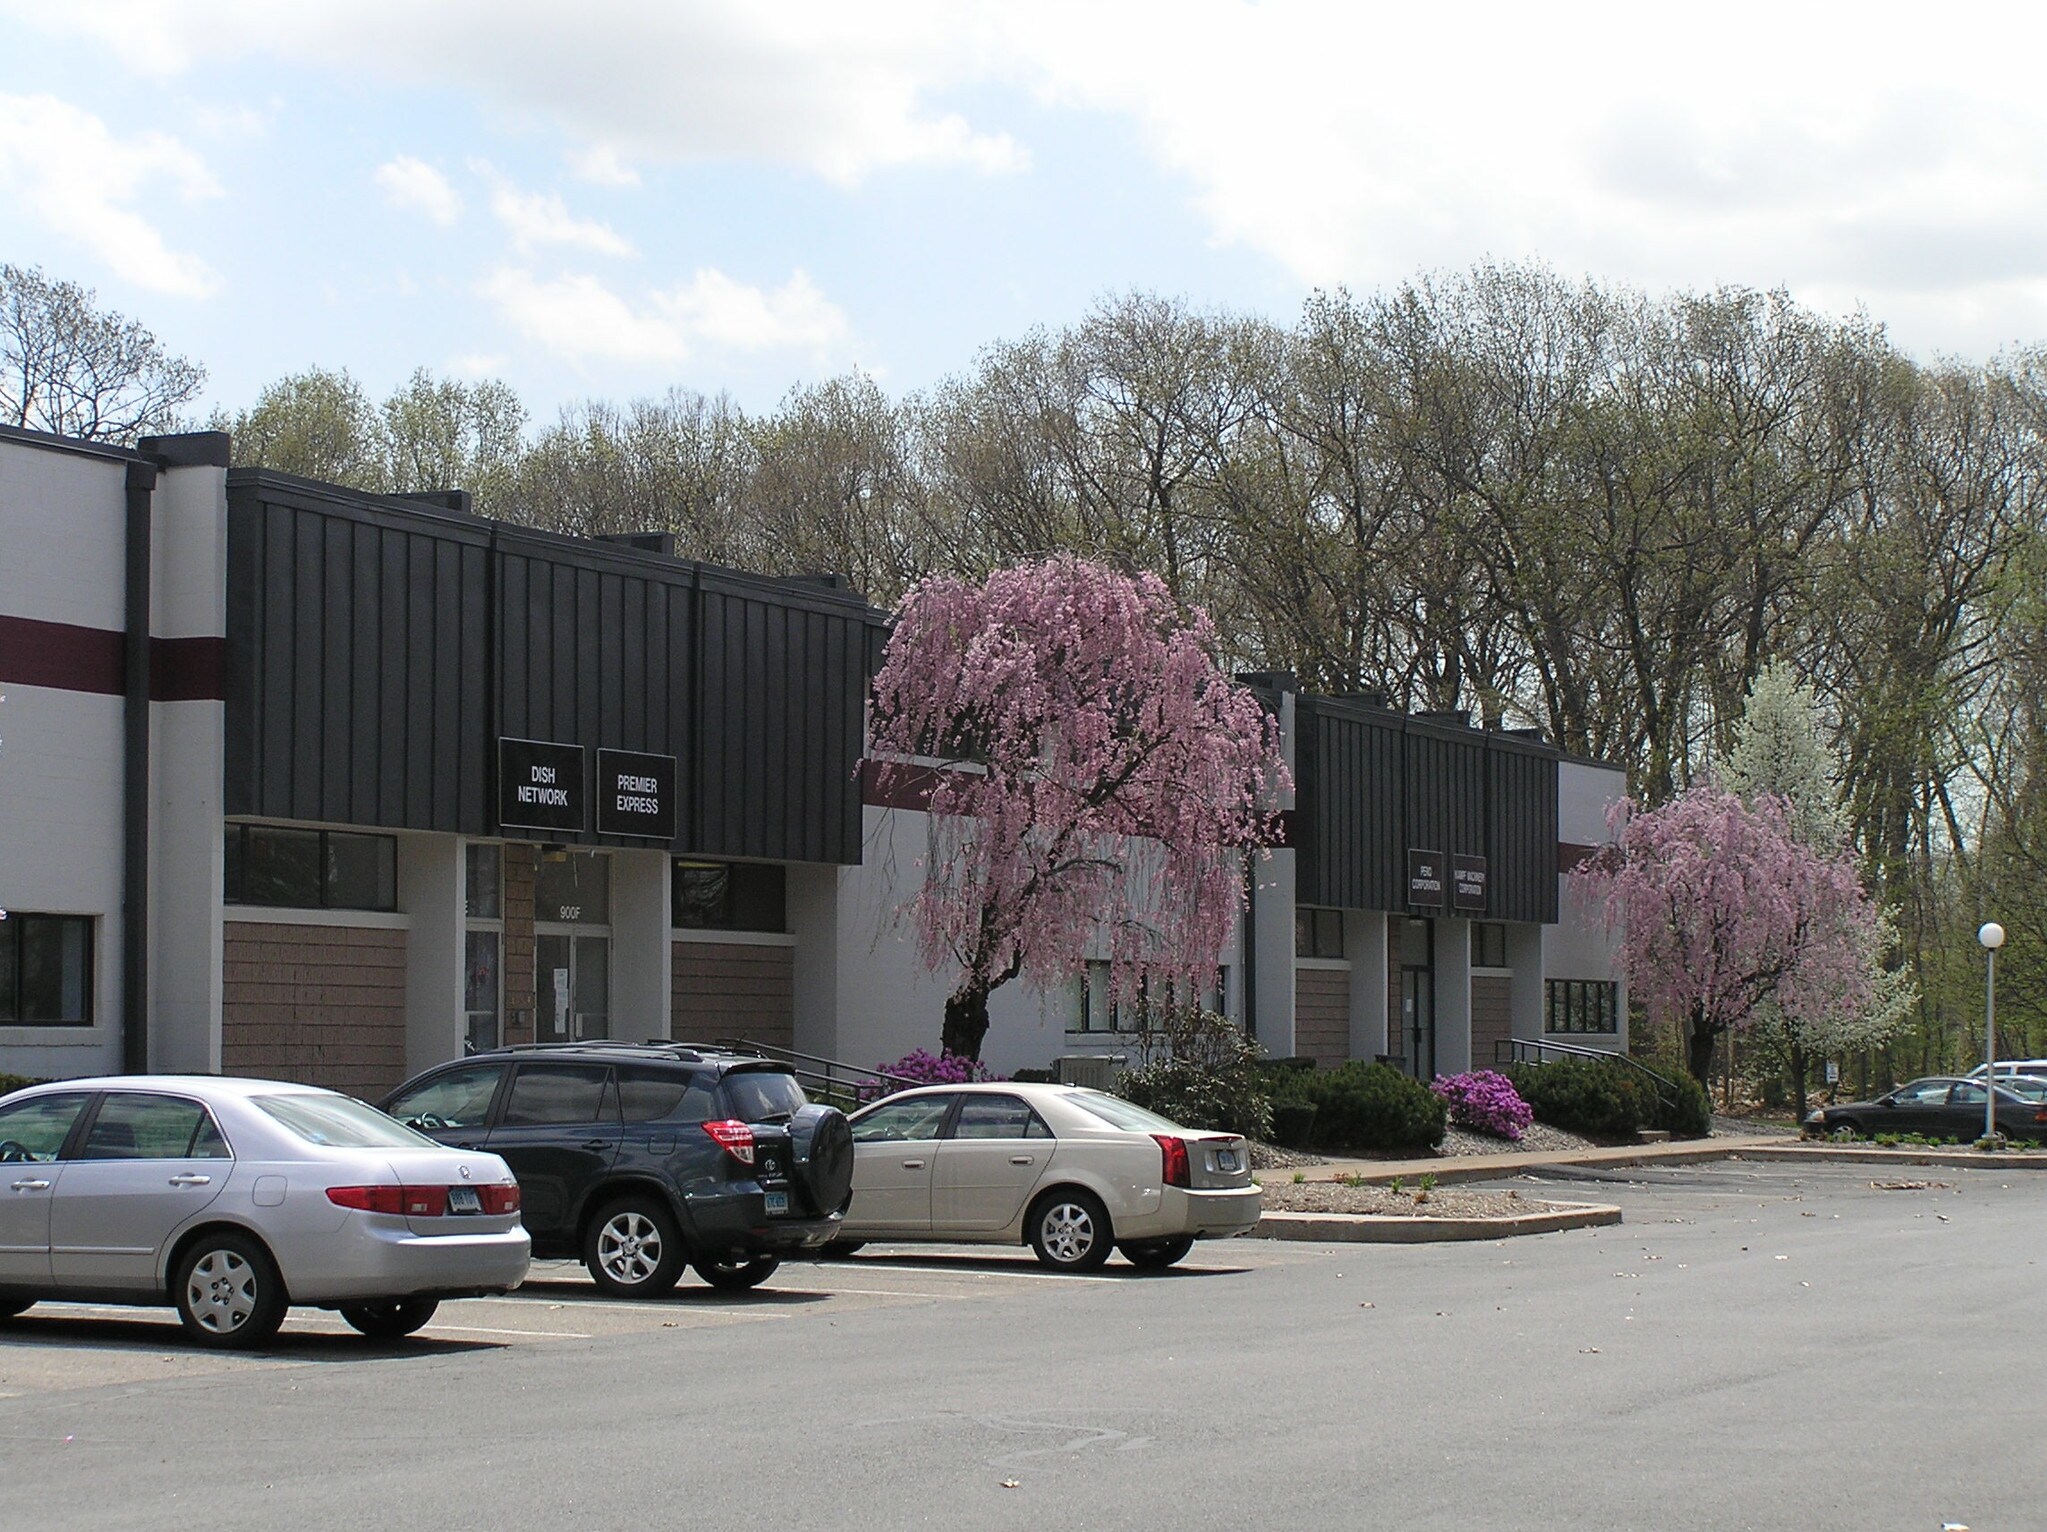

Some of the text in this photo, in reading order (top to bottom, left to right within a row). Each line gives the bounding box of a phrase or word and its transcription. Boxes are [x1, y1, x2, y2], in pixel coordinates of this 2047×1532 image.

[531, 766, 556, 784] DISH
[617, 774, 658, 794] PREMIER
[518, 786, 568, 806] NETWORK
[616, 795, 659, 815] EXPRESS
[559, 905, 581, 920] 900F
